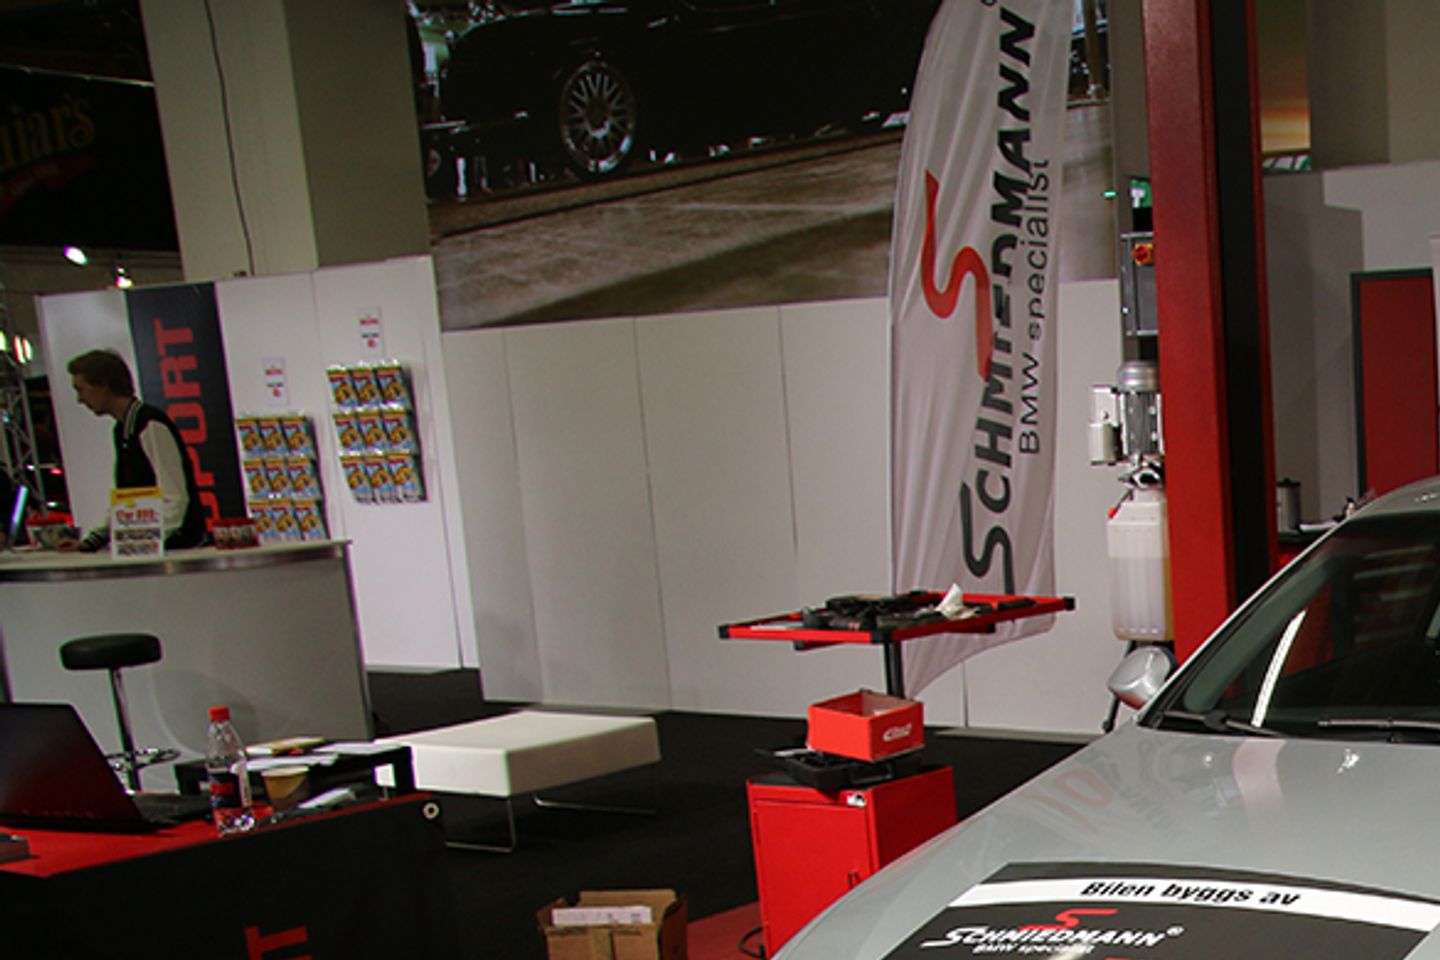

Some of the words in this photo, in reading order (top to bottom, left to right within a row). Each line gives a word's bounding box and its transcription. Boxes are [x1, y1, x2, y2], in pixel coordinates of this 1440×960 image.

[1019, 354, 1040, 455] BMW
[1081, 881, 1156, 898] Bilen
[1163, 882, 1254, 904] byggs
[1260, 890, 1303, 905] av
